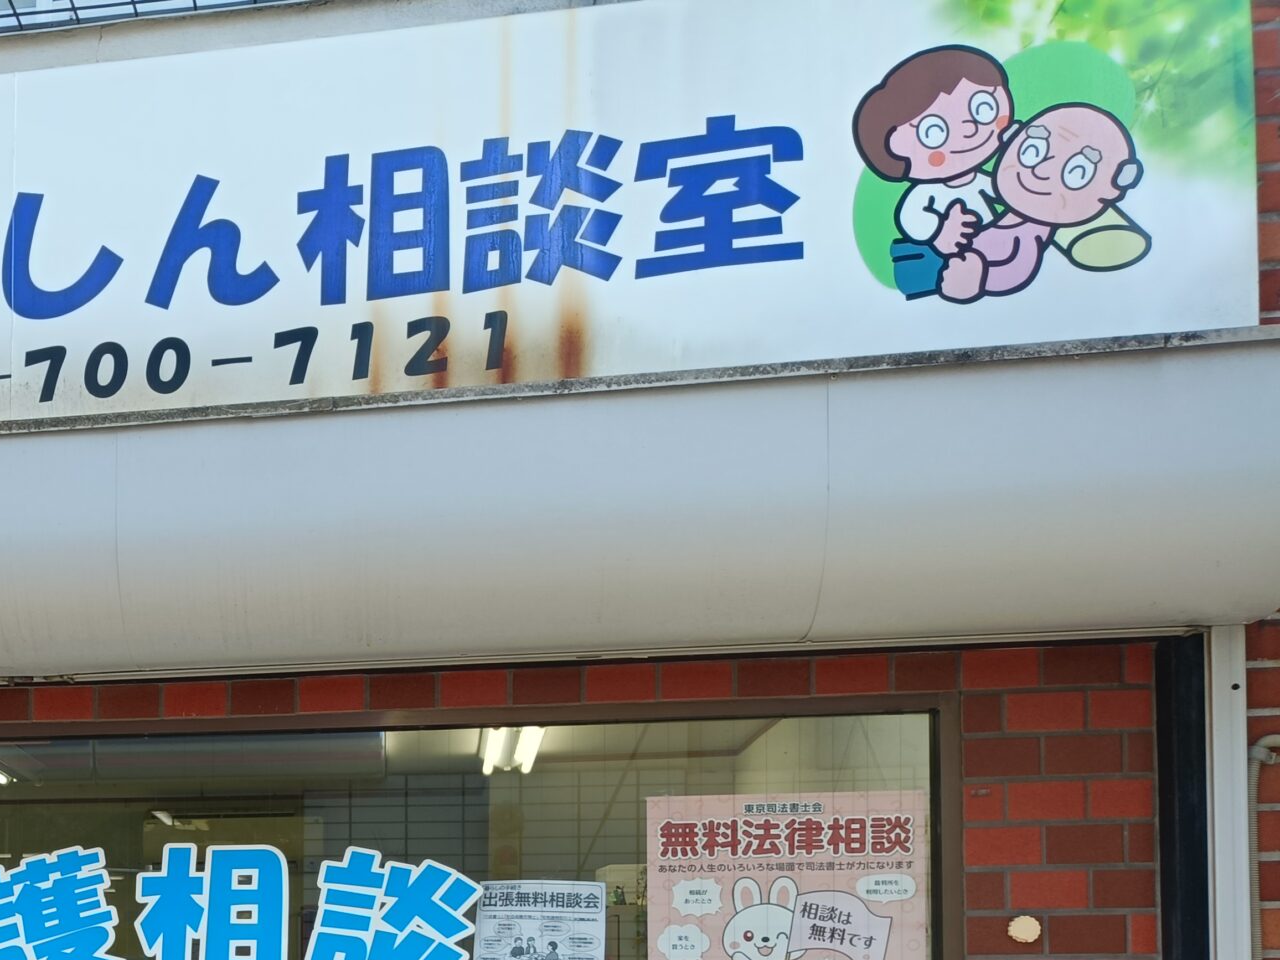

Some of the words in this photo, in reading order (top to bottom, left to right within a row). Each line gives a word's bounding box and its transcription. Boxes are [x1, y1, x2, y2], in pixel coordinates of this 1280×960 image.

[744, 803, 823, 814] 東京司法書士会
[659, 816, 915, 858] 無料法律相談
[658, 861, 914, 873] あなたの人生のいろいろな場面で司法書士が力になります
[482, 892, 600, 909] 出張無料相談会
[799, 901, 853, 926] 相談は
[808, 923, 877, 950] 無料です
